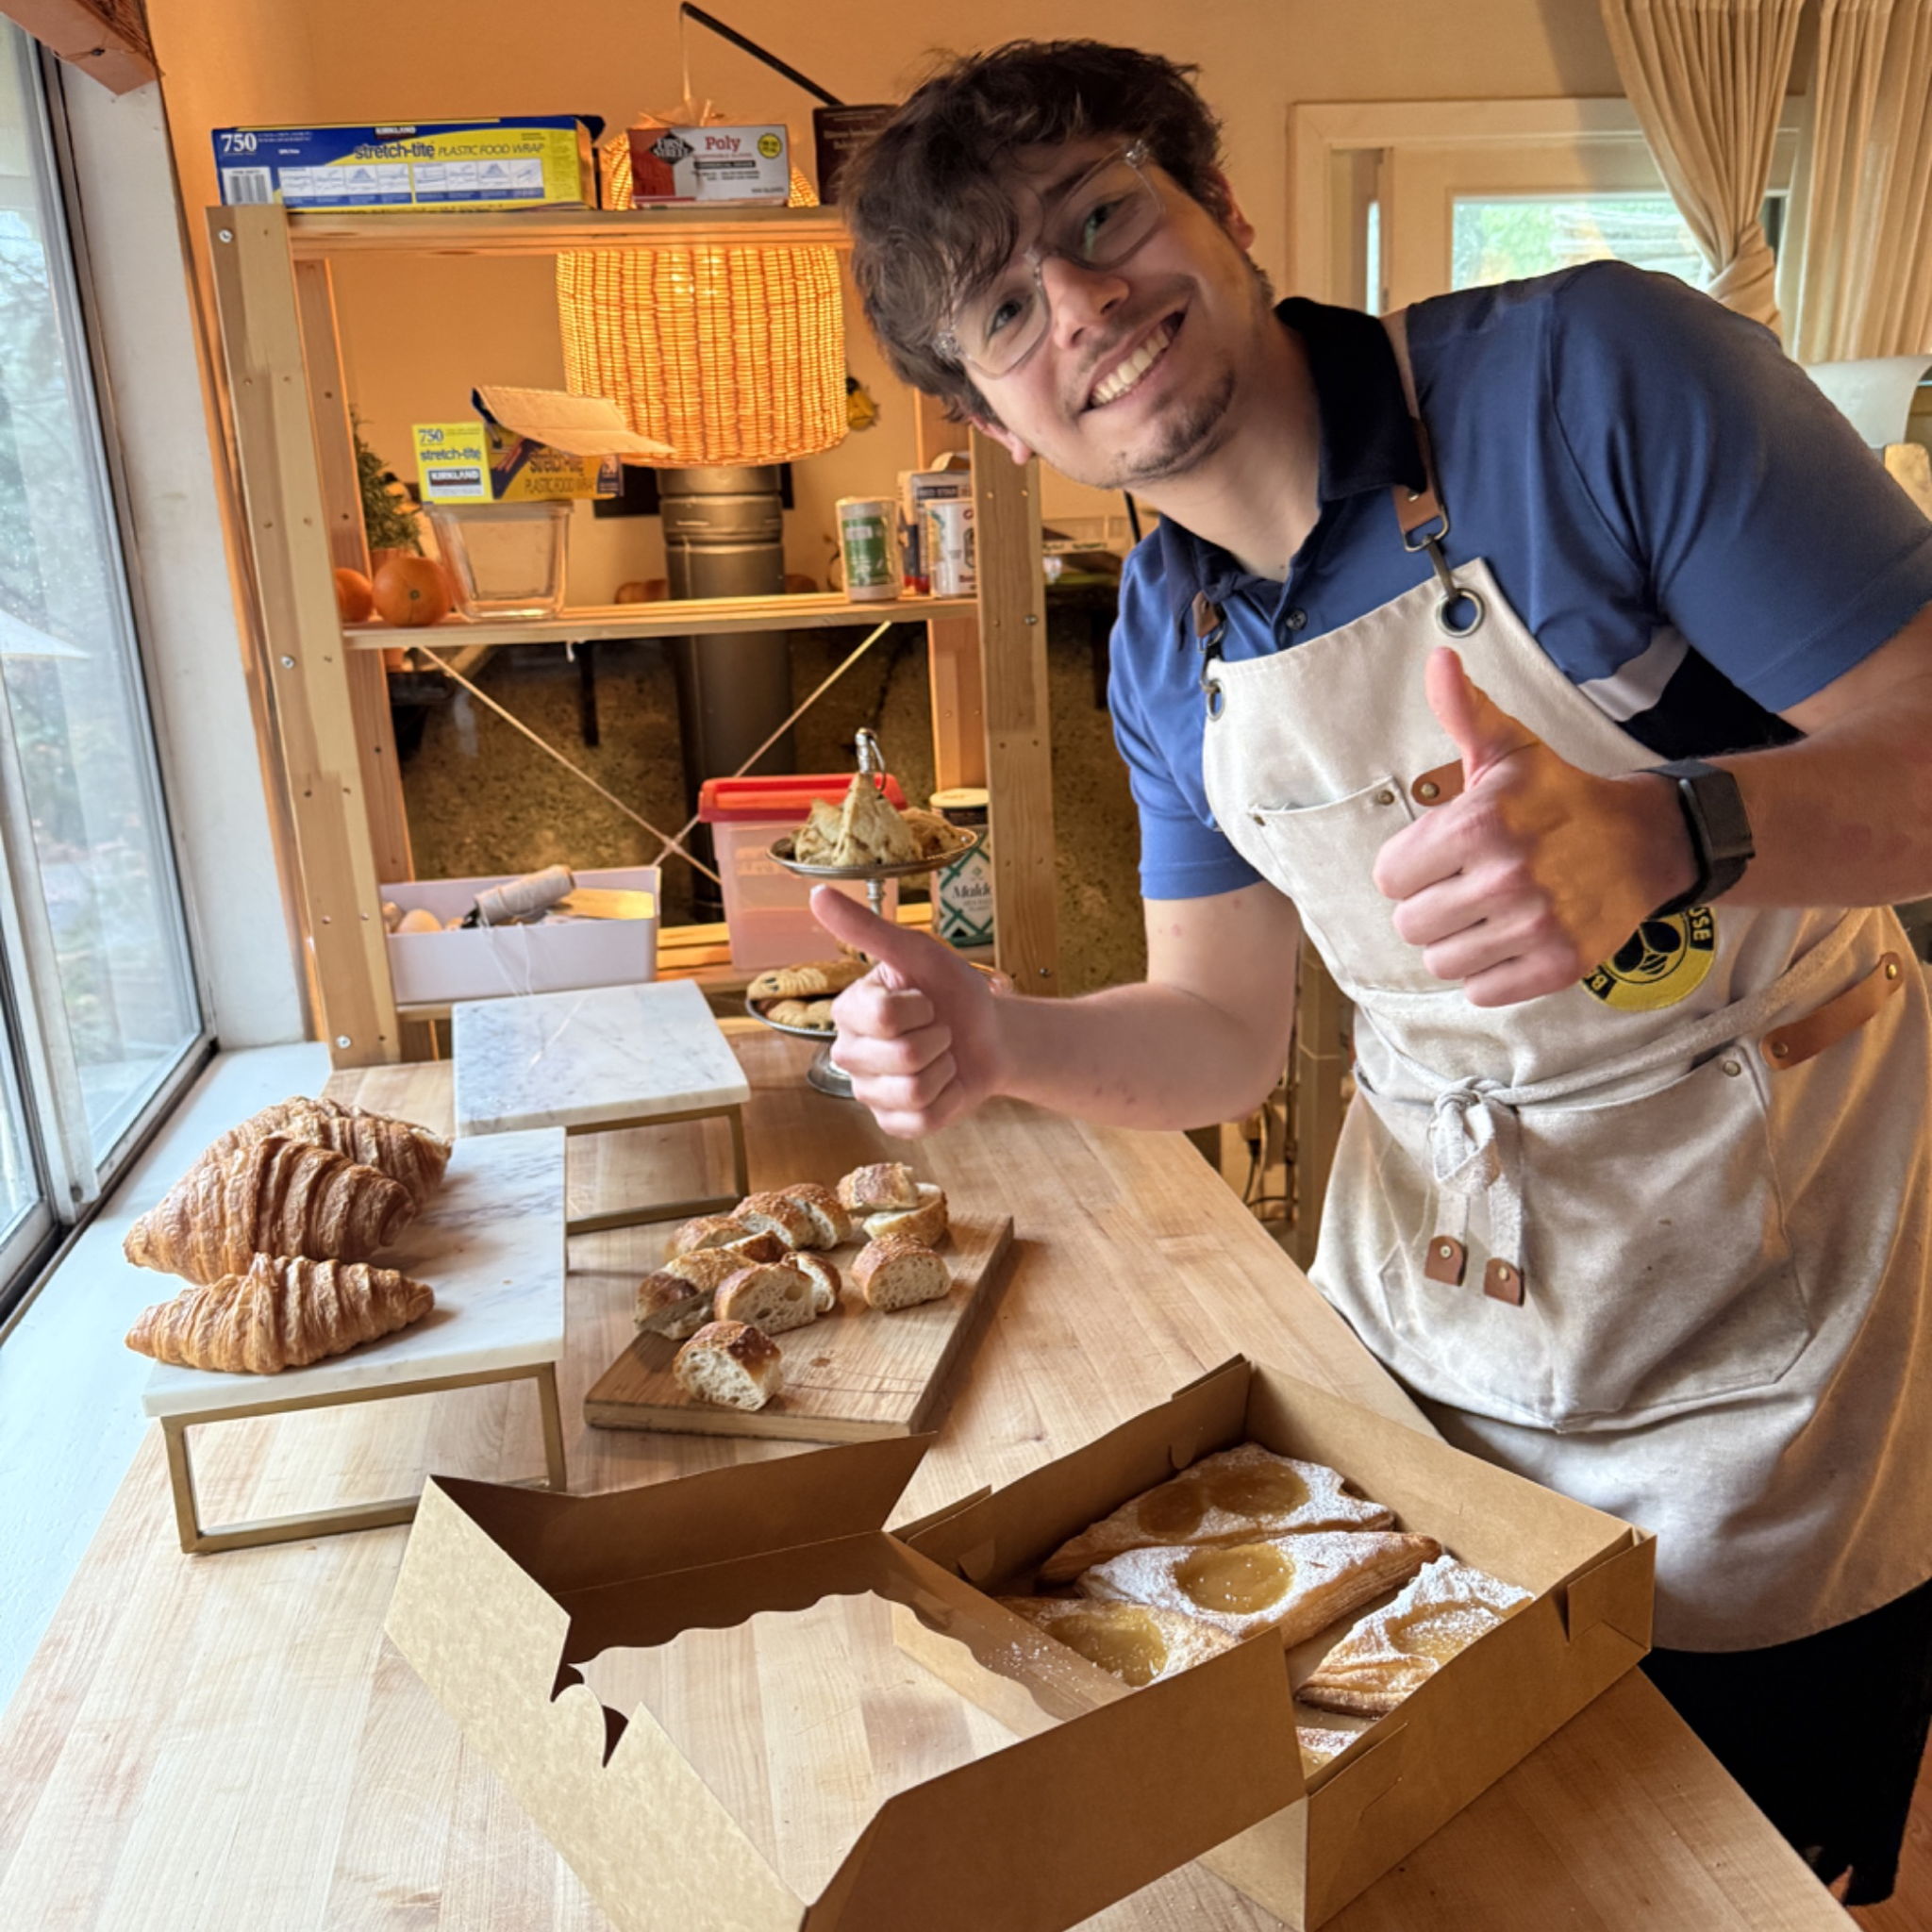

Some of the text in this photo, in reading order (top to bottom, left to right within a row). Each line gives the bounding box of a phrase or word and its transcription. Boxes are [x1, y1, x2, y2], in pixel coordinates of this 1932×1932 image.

[221, 132, 258, 152] 750
[355, 142, 545, 159] stretch-tite PLASTIC FOOD WRAP
[705, 135, 741, 152] Poly
[418, 428, 444, 445] 750
[430, 470, 479, 482] KIRKLAND
